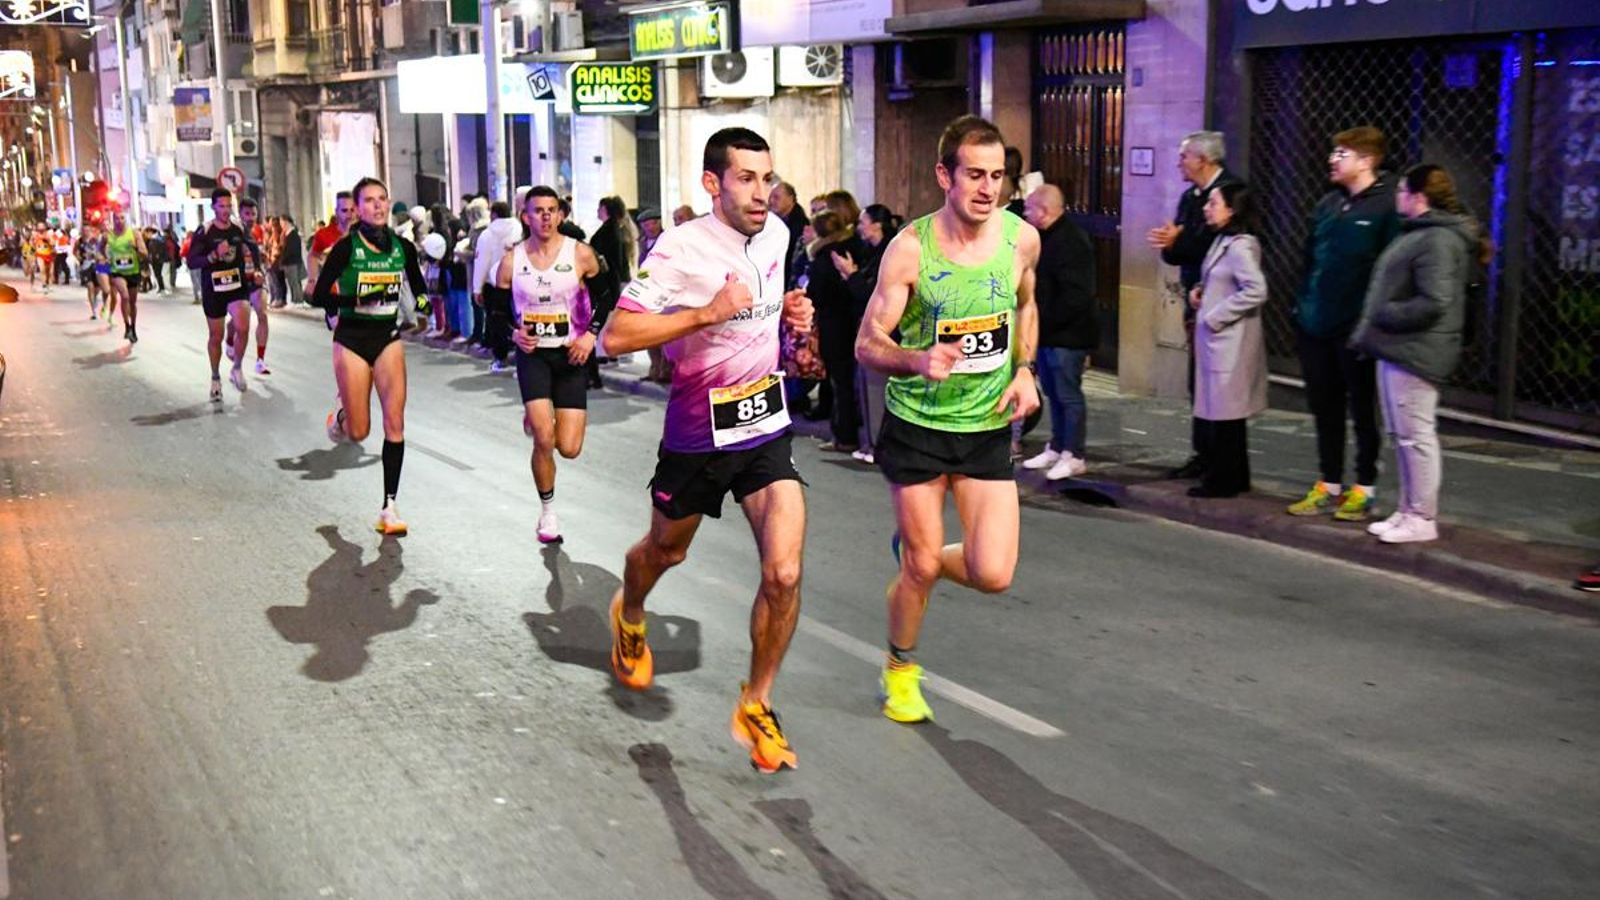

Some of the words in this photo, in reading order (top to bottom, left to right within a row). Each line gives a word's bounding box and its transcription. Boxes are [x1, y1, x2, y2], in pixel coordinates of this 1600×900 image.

[576, 66, 652, 84] ANALISIS
[576, 84, 653, 103] CLINICOS
[535, 323, 556, 336] 84
[960, 331, 994, 354] 93
[737, 392, 768, 420] 85
